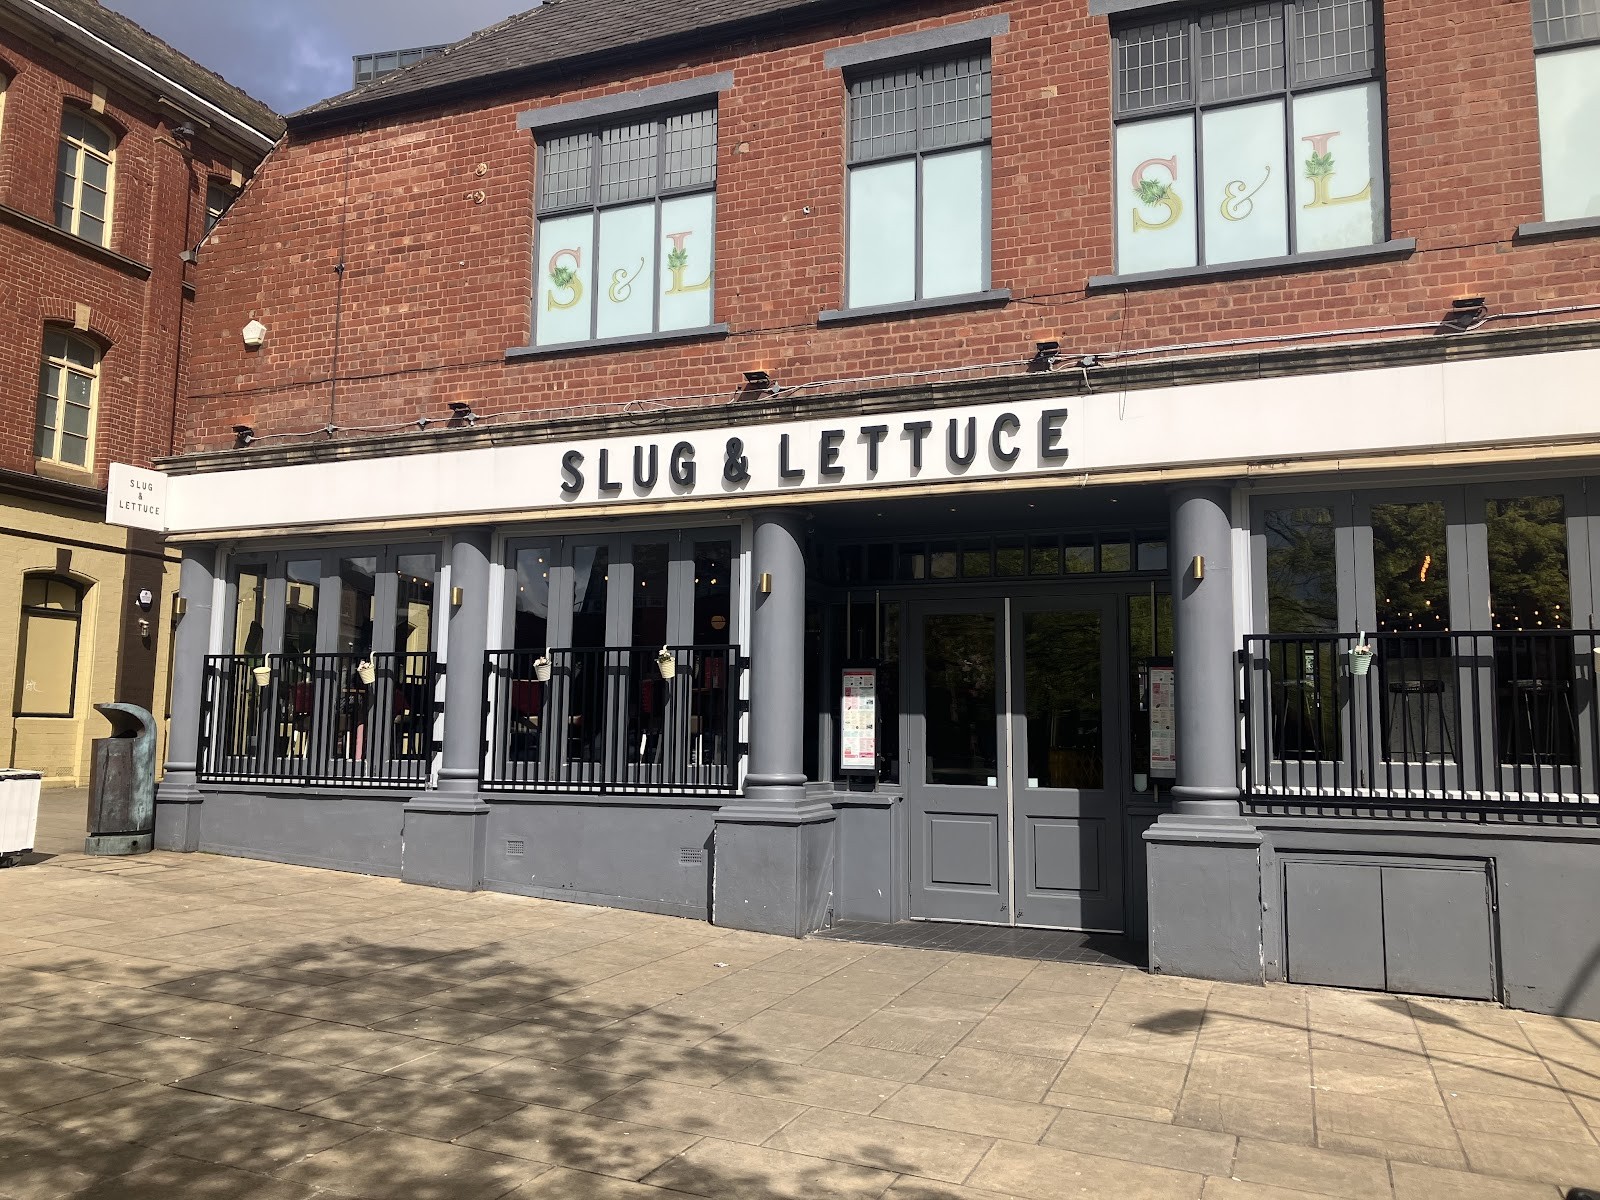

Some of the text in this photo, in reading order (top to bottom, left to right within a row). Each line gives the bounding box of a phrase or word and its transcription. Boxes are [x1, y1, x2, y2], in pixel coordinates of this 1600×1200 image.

[1132, 131, 1374, 233] S & L
[547, 230, 712, 312] S & L
[560, 408, 1069, 494] SLUG & LETTUCE
[119, 500, 160, 516] LETTUCE
[130, 479, 153, 492] SLUG
[138, 492, 143, 501] &
